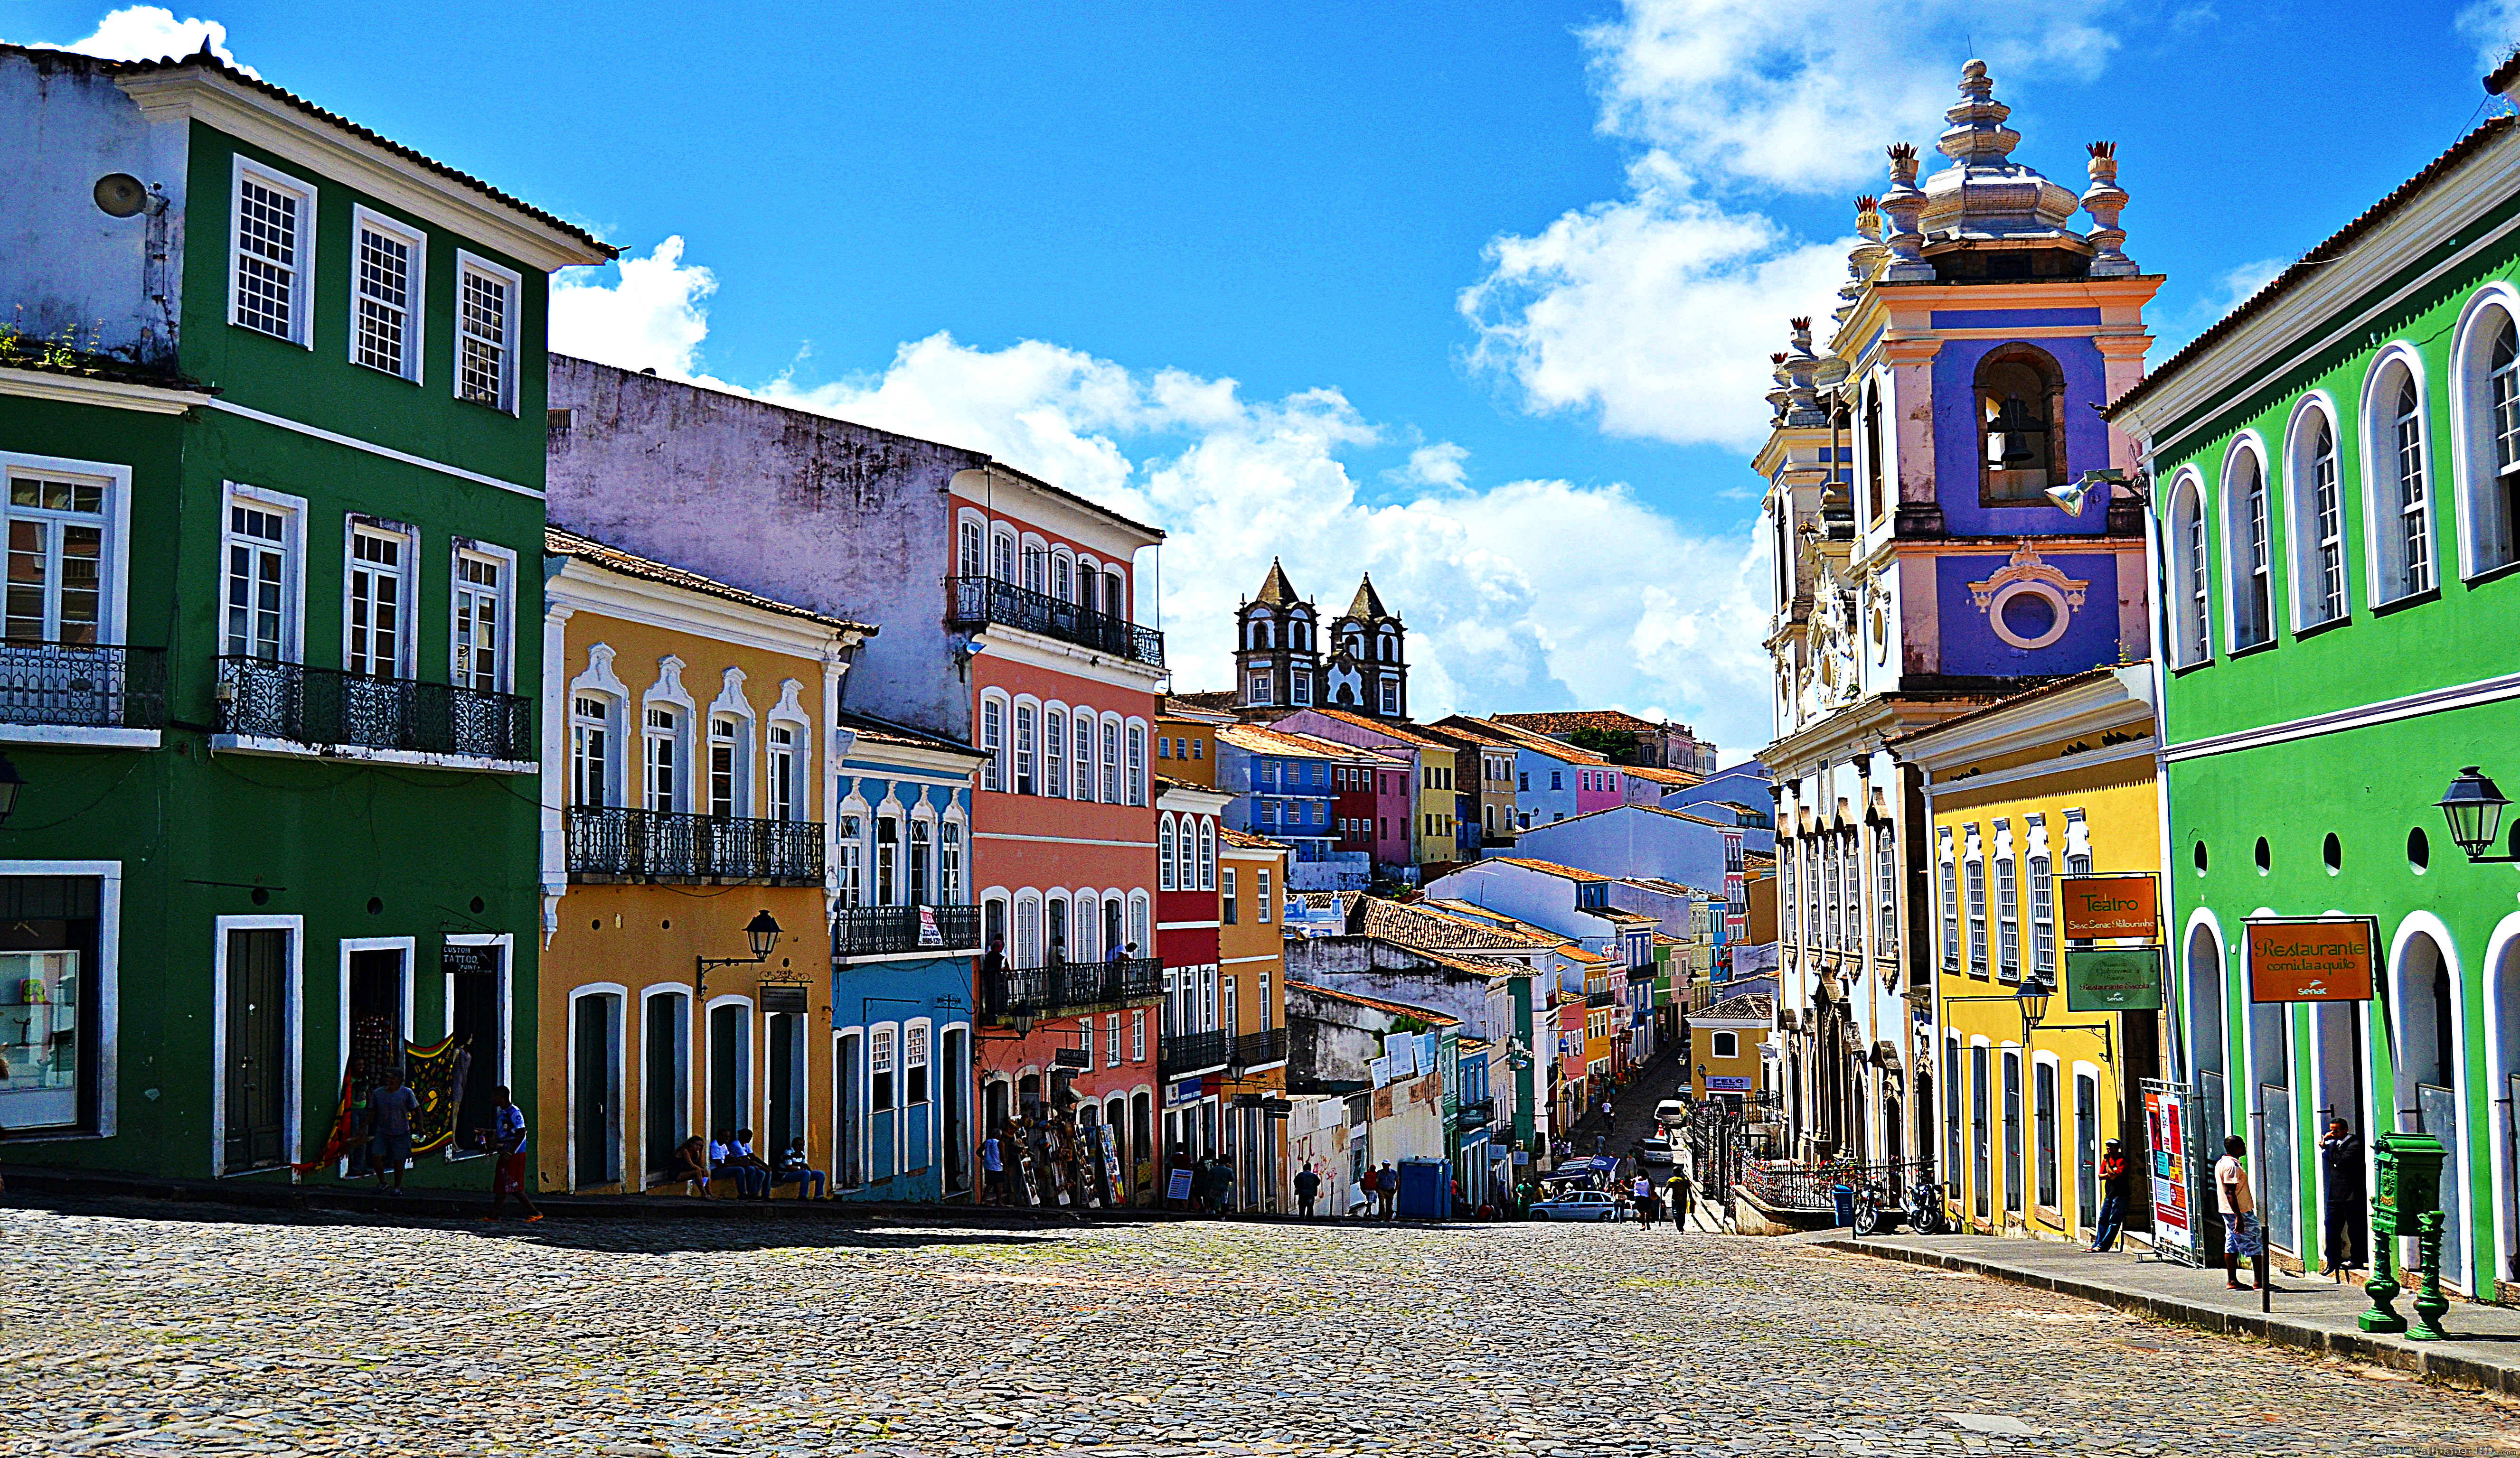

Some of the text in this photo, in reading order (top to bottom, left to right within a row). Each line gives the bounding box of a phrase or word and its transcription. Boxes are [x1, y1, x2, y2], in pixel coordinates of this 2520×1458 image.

[2080, 894, 2139, 912] Teatro
[2069, 918, 2155, 930] Sesc Senac Pelourinho
[2255, 938, 2365, 957] Restaurante
[2266, 958, 2313, 971] comida
[2323, 958, 2356, 976] quilo
